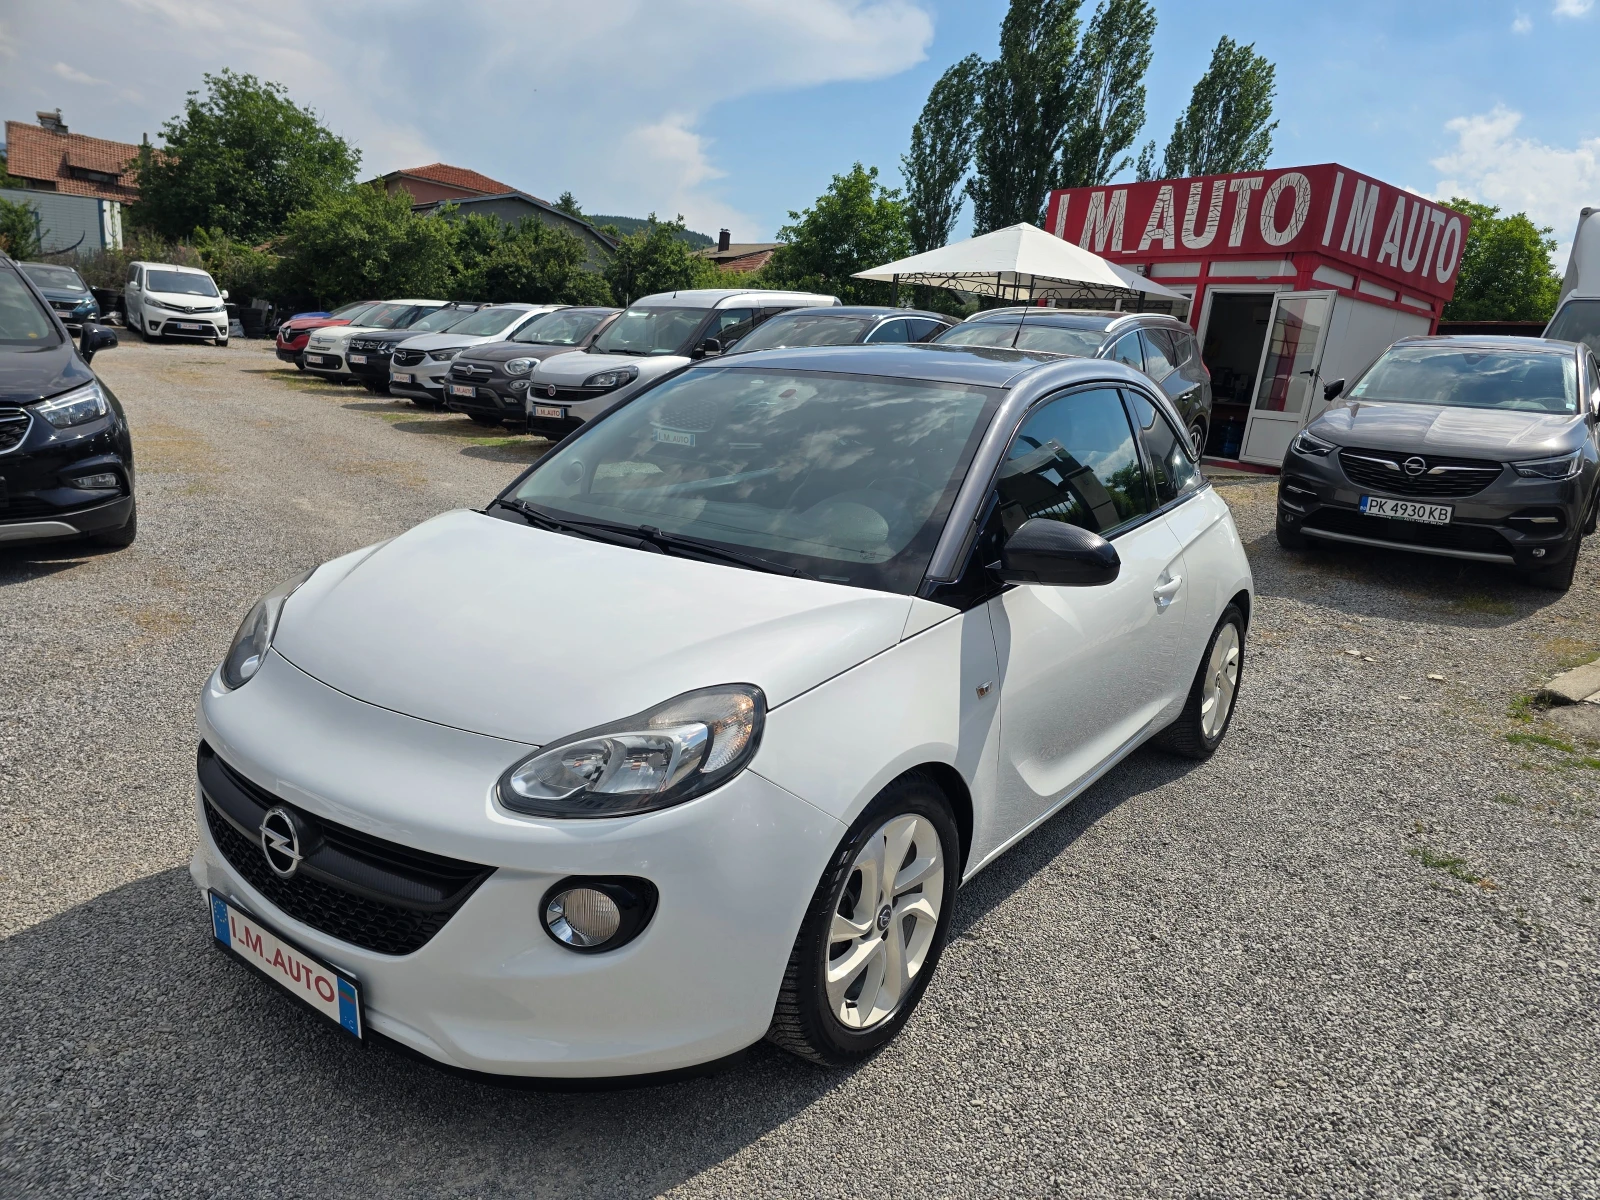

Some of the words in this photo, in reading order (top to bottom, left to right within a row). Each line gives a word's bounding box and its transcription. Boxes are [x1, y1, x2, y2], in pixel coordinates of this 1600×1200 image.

[1321, 171, 1345, 247] I
[1339, 178, 1380, 259] M
[1376, 195, 1462, 284] AUTO
[1368, 499, 1388, 514] PK
[1390, 502, 1426, 518] 4930
[1427, 506, 1448, 521] KB
